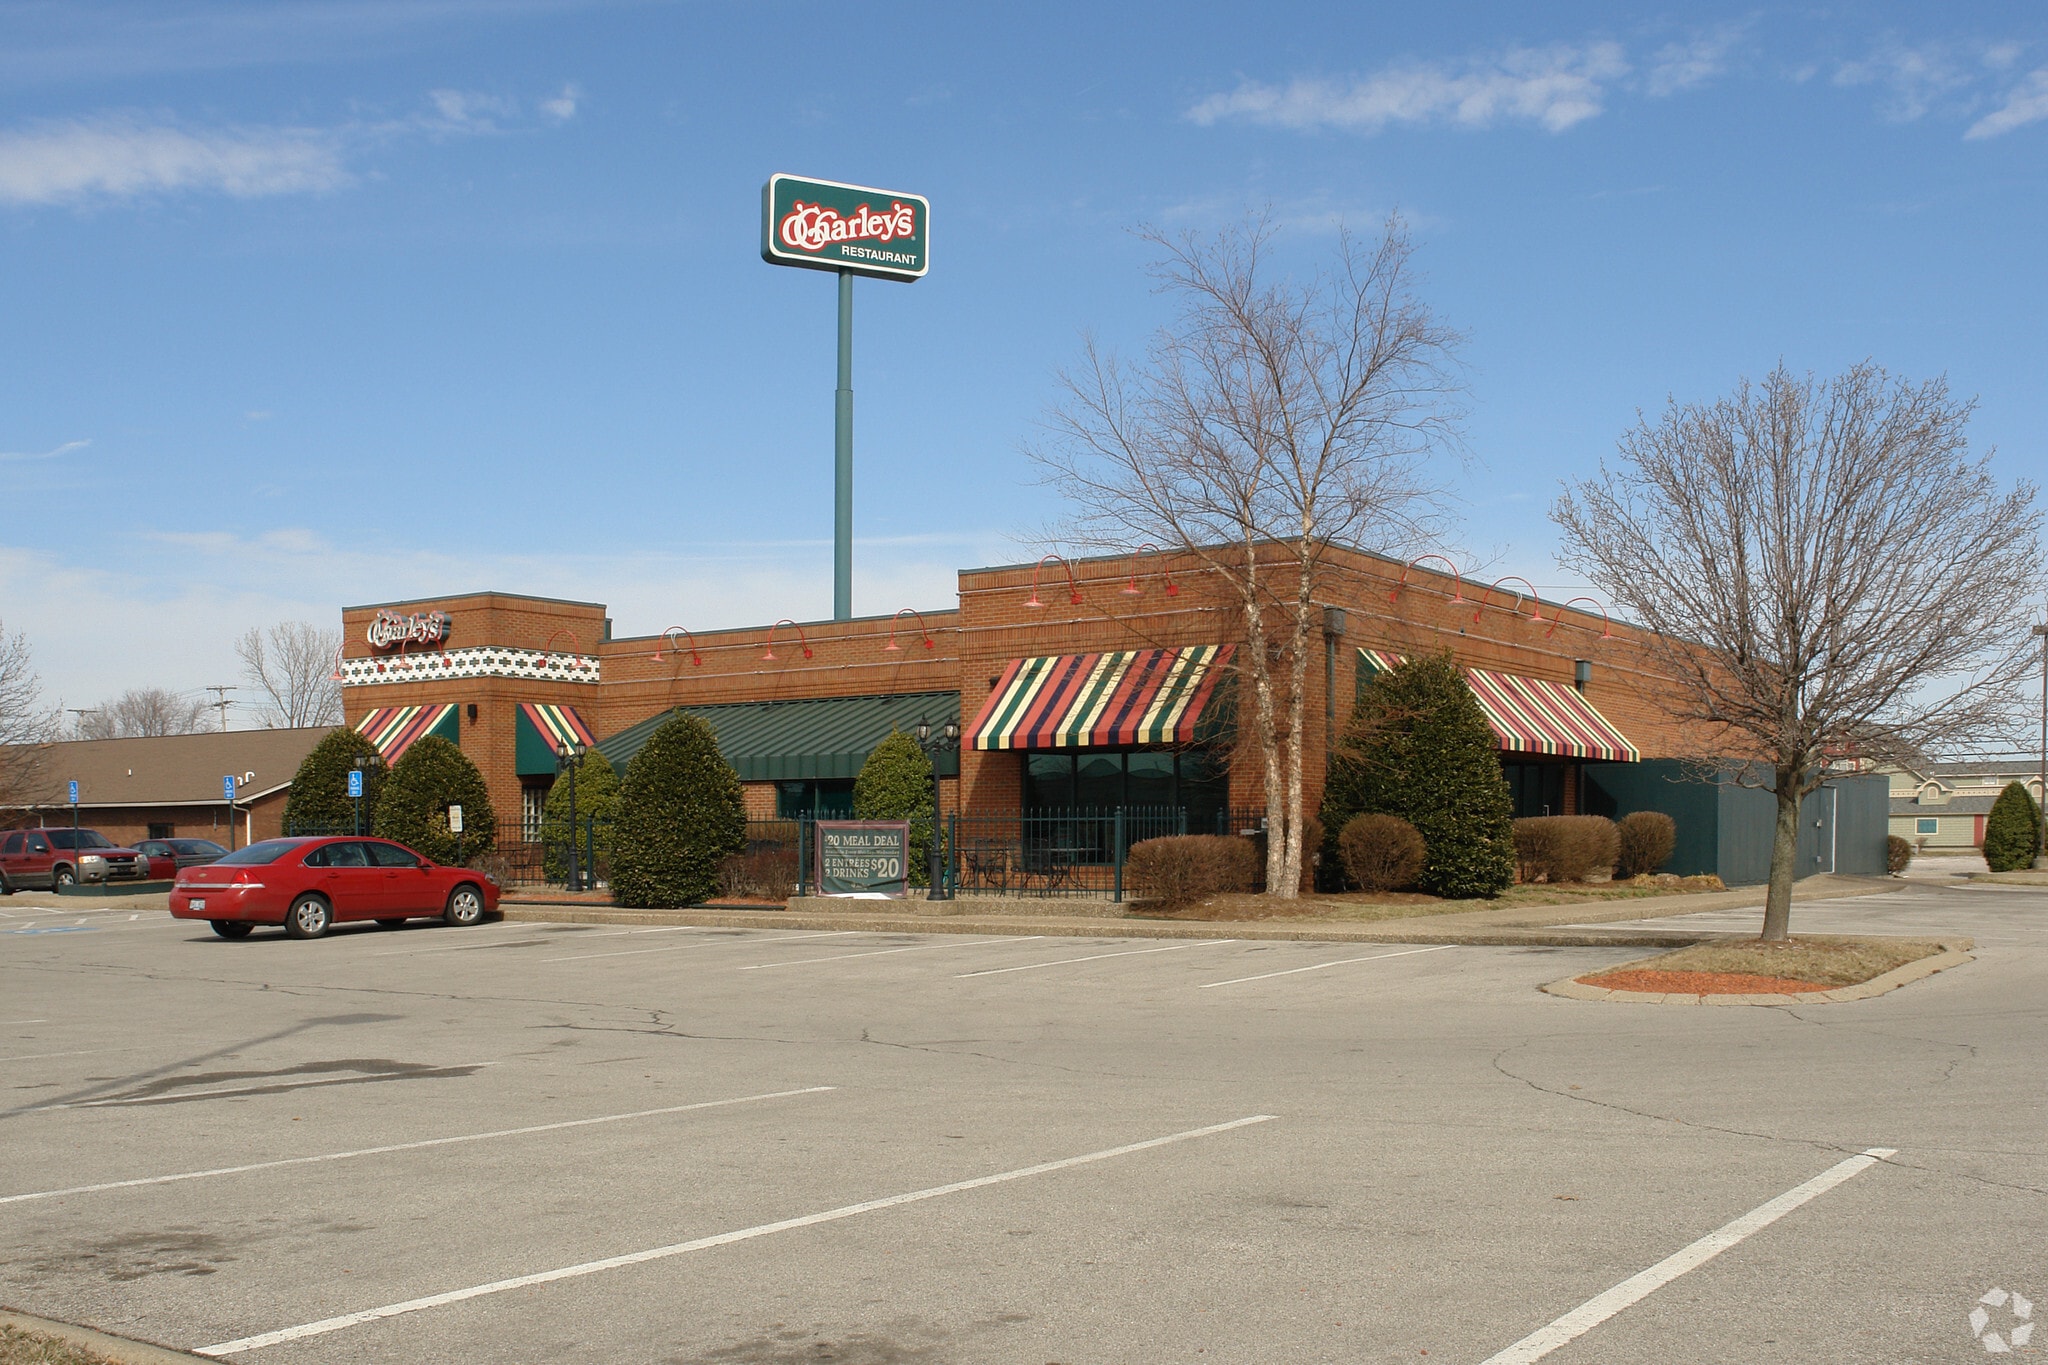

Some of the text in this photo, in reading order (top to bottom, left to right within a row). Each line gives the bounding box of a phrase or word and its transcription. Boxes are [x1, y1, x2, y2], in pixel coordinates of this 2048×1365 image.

[781, 202, 914, 250] O'Charley's
[841, 245, 917, 265] RESTAURANT
[843, 835, 871, 846] MEAL
[874, 835, 899, 846] DEAL
[825, 858, 831, 867] 2
[870, 858, 899, 878] $20
[825, 868, 869, 878] 2 DRINKS
